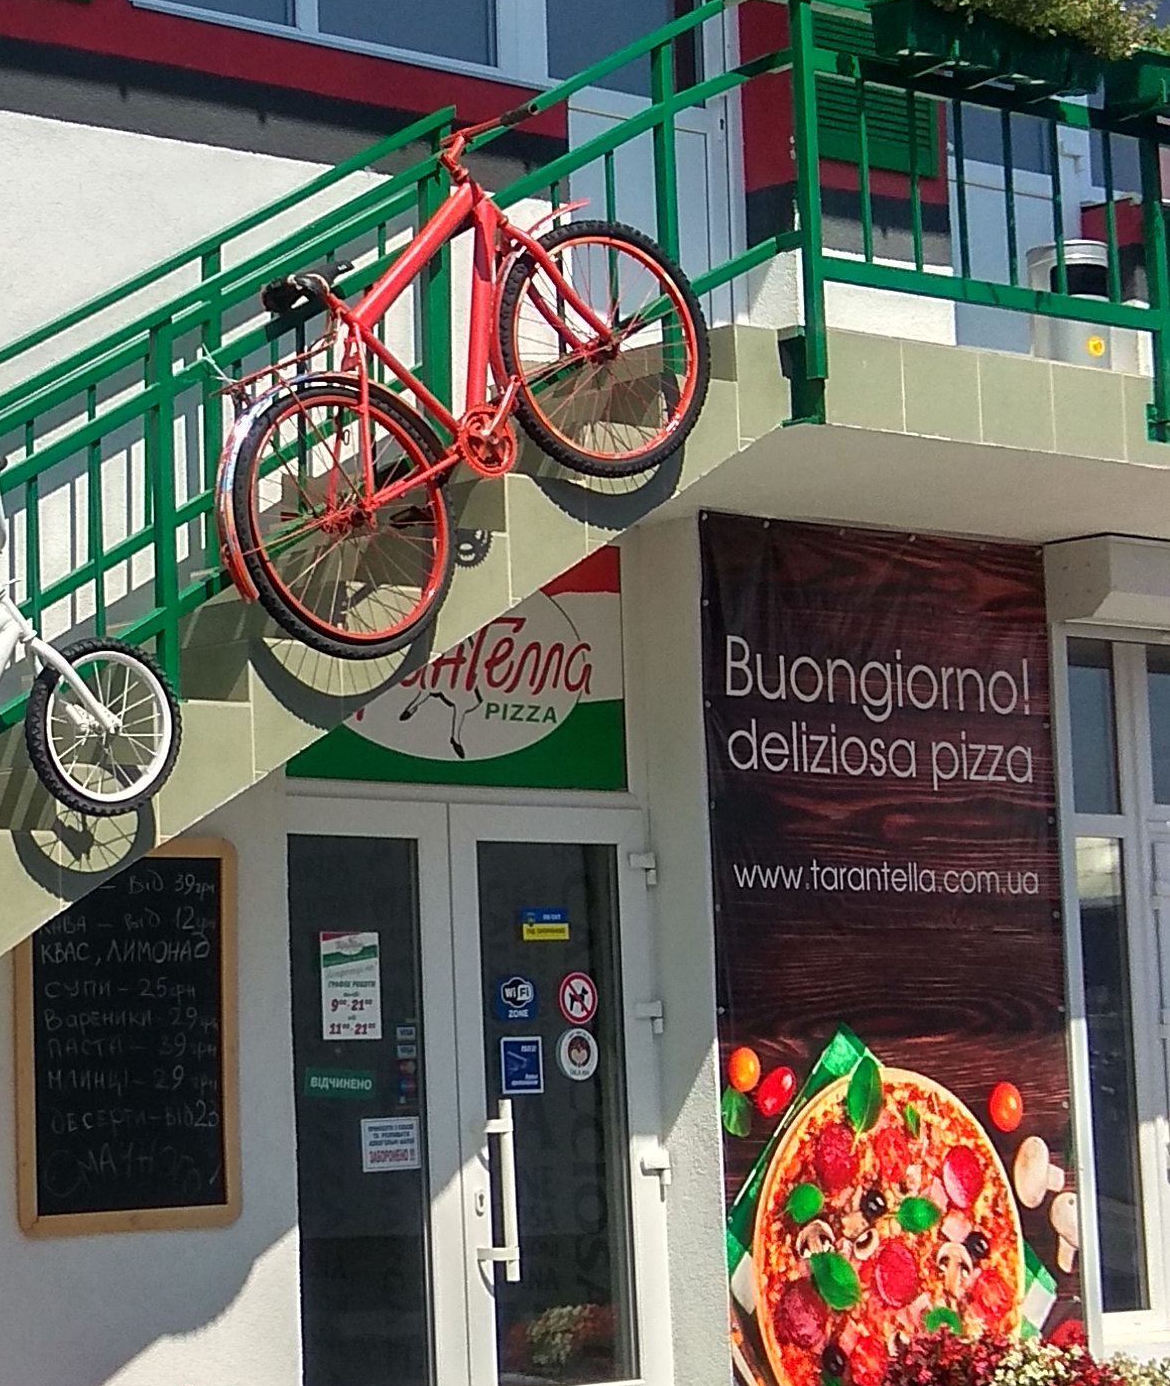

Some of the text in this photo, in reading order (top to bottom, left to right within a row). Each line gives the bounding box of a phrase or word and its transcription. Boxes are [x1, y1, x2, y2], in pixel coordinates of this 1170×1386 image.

[725, 634, 1030, 722] Buongiorno!
[485, 702, 558, 724] PIZZA
[728, 718, 1033, 791] deliziosa pizza
[733, 858, 1039, 895] www.tarantella.com.ua
[44, 980, 111, 999] СУПИ
[508, 1009, 529, 1018] ZONE
[310, 1076, 373, 1091] ВІДЧИНЕНО
